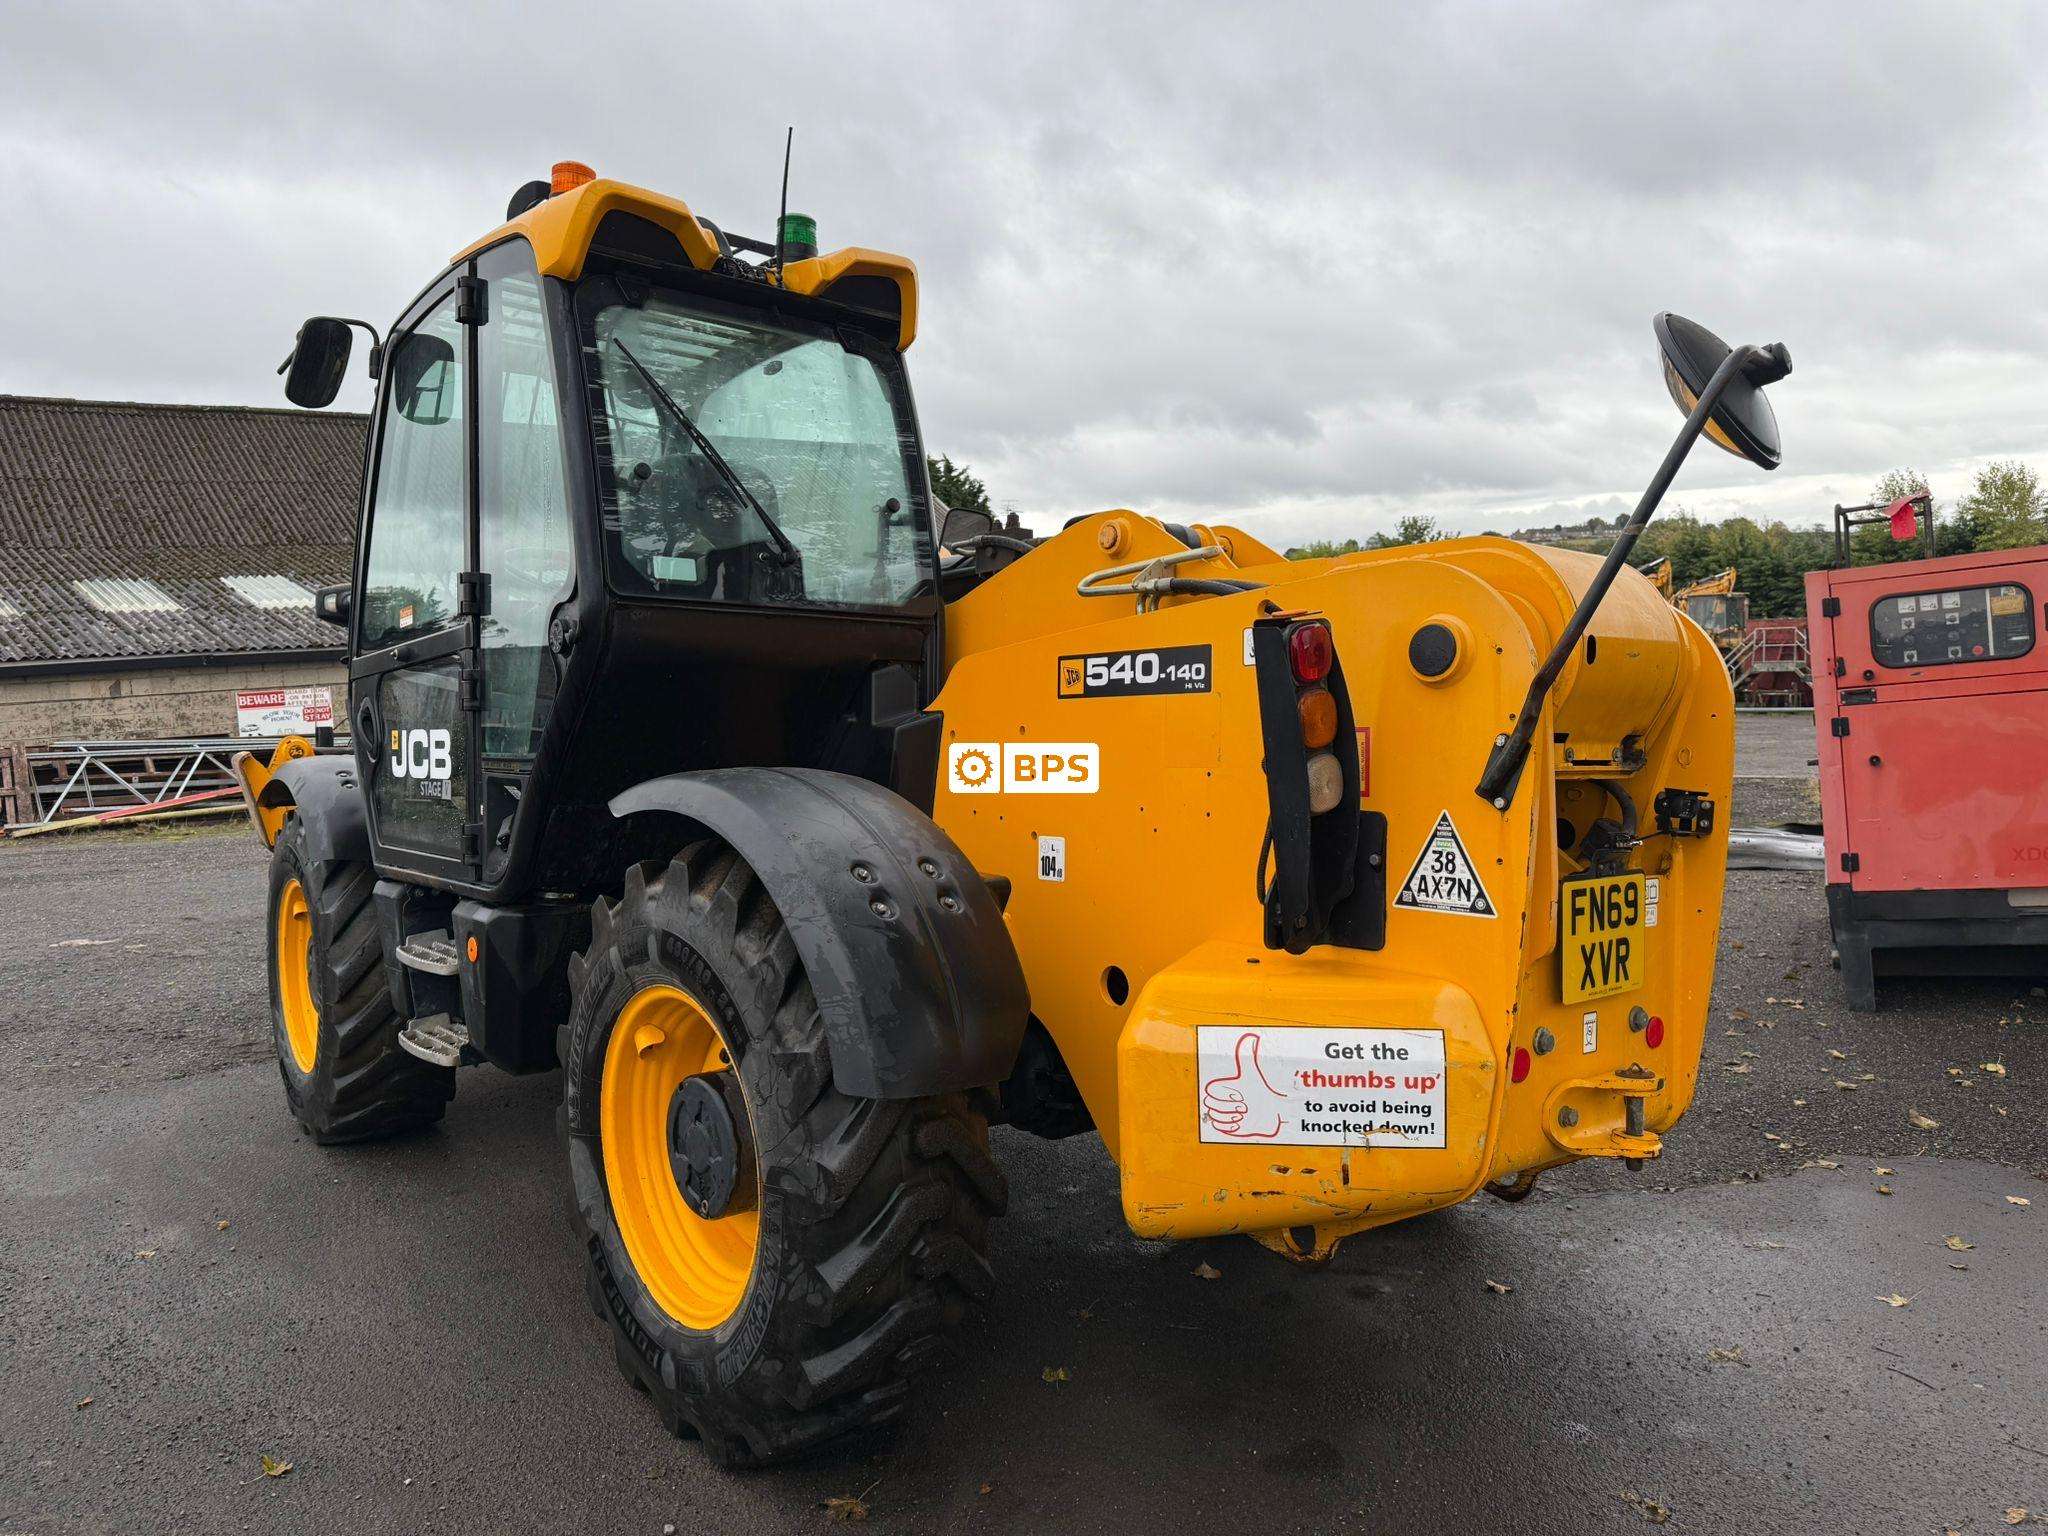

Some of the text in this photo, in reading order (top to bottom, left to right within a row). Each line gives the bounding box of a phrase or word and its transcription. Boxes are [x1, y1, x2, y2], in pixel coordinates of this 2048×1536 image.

[1065, 667, 1081, 687] JCB
[238, 693, 285, 706] BEWARE
[391, 728, 452, 780] JCB
[420, 780, 442, 797] STAGE
[1040, 855, 1056, 877] 104
[1431, 850, 1456, 875] 38
[1416, 874, 1472, 902] AX7N
[1571, 881, 1639, 936] FN69
[1580, 937, 1631, 990] XVR
[1324, 1042, 1409, 1061] Get the
[1304, 1100, 1432, 1117] to avoid being
[1301, 1119, 1436, 1135] knocked down!
